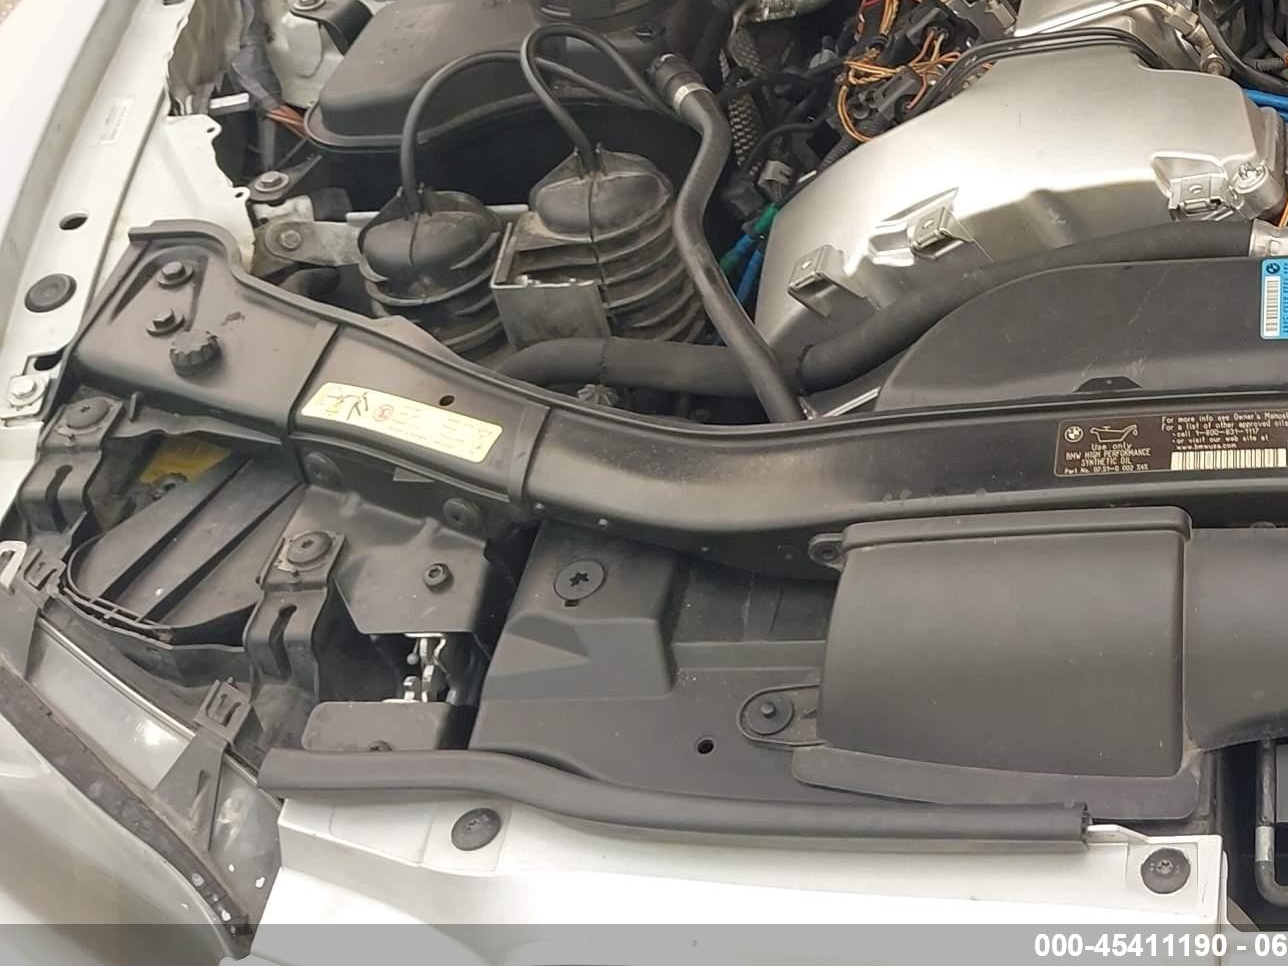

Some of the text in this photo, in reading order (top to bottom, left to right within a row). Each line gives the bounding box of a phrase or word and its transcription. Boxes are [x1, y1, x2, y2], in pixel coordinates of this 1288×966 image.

[1161, 416, 1174, 424] For
[1199, 414, 1215, 422] info
[1264, 411, 1288, 420] Manual
[1161, 423, 1174, 431] For
[1186, 421, 1199, 430] list
[1215, 420, 1234, 429] other
[1238, 420, 1271, 428] approved
[1274, 419, 1288, 427] oils
[1188, 436, 1205, 444] visit
[1242, 434, 1257, 442] site
[1091, 441, 1133, 451] Use only
[1065, 447, 1152, 461] BMW HIGH PERFORMANCE
[1081, 456, 1132, 467] SYNTHETIC OIL
